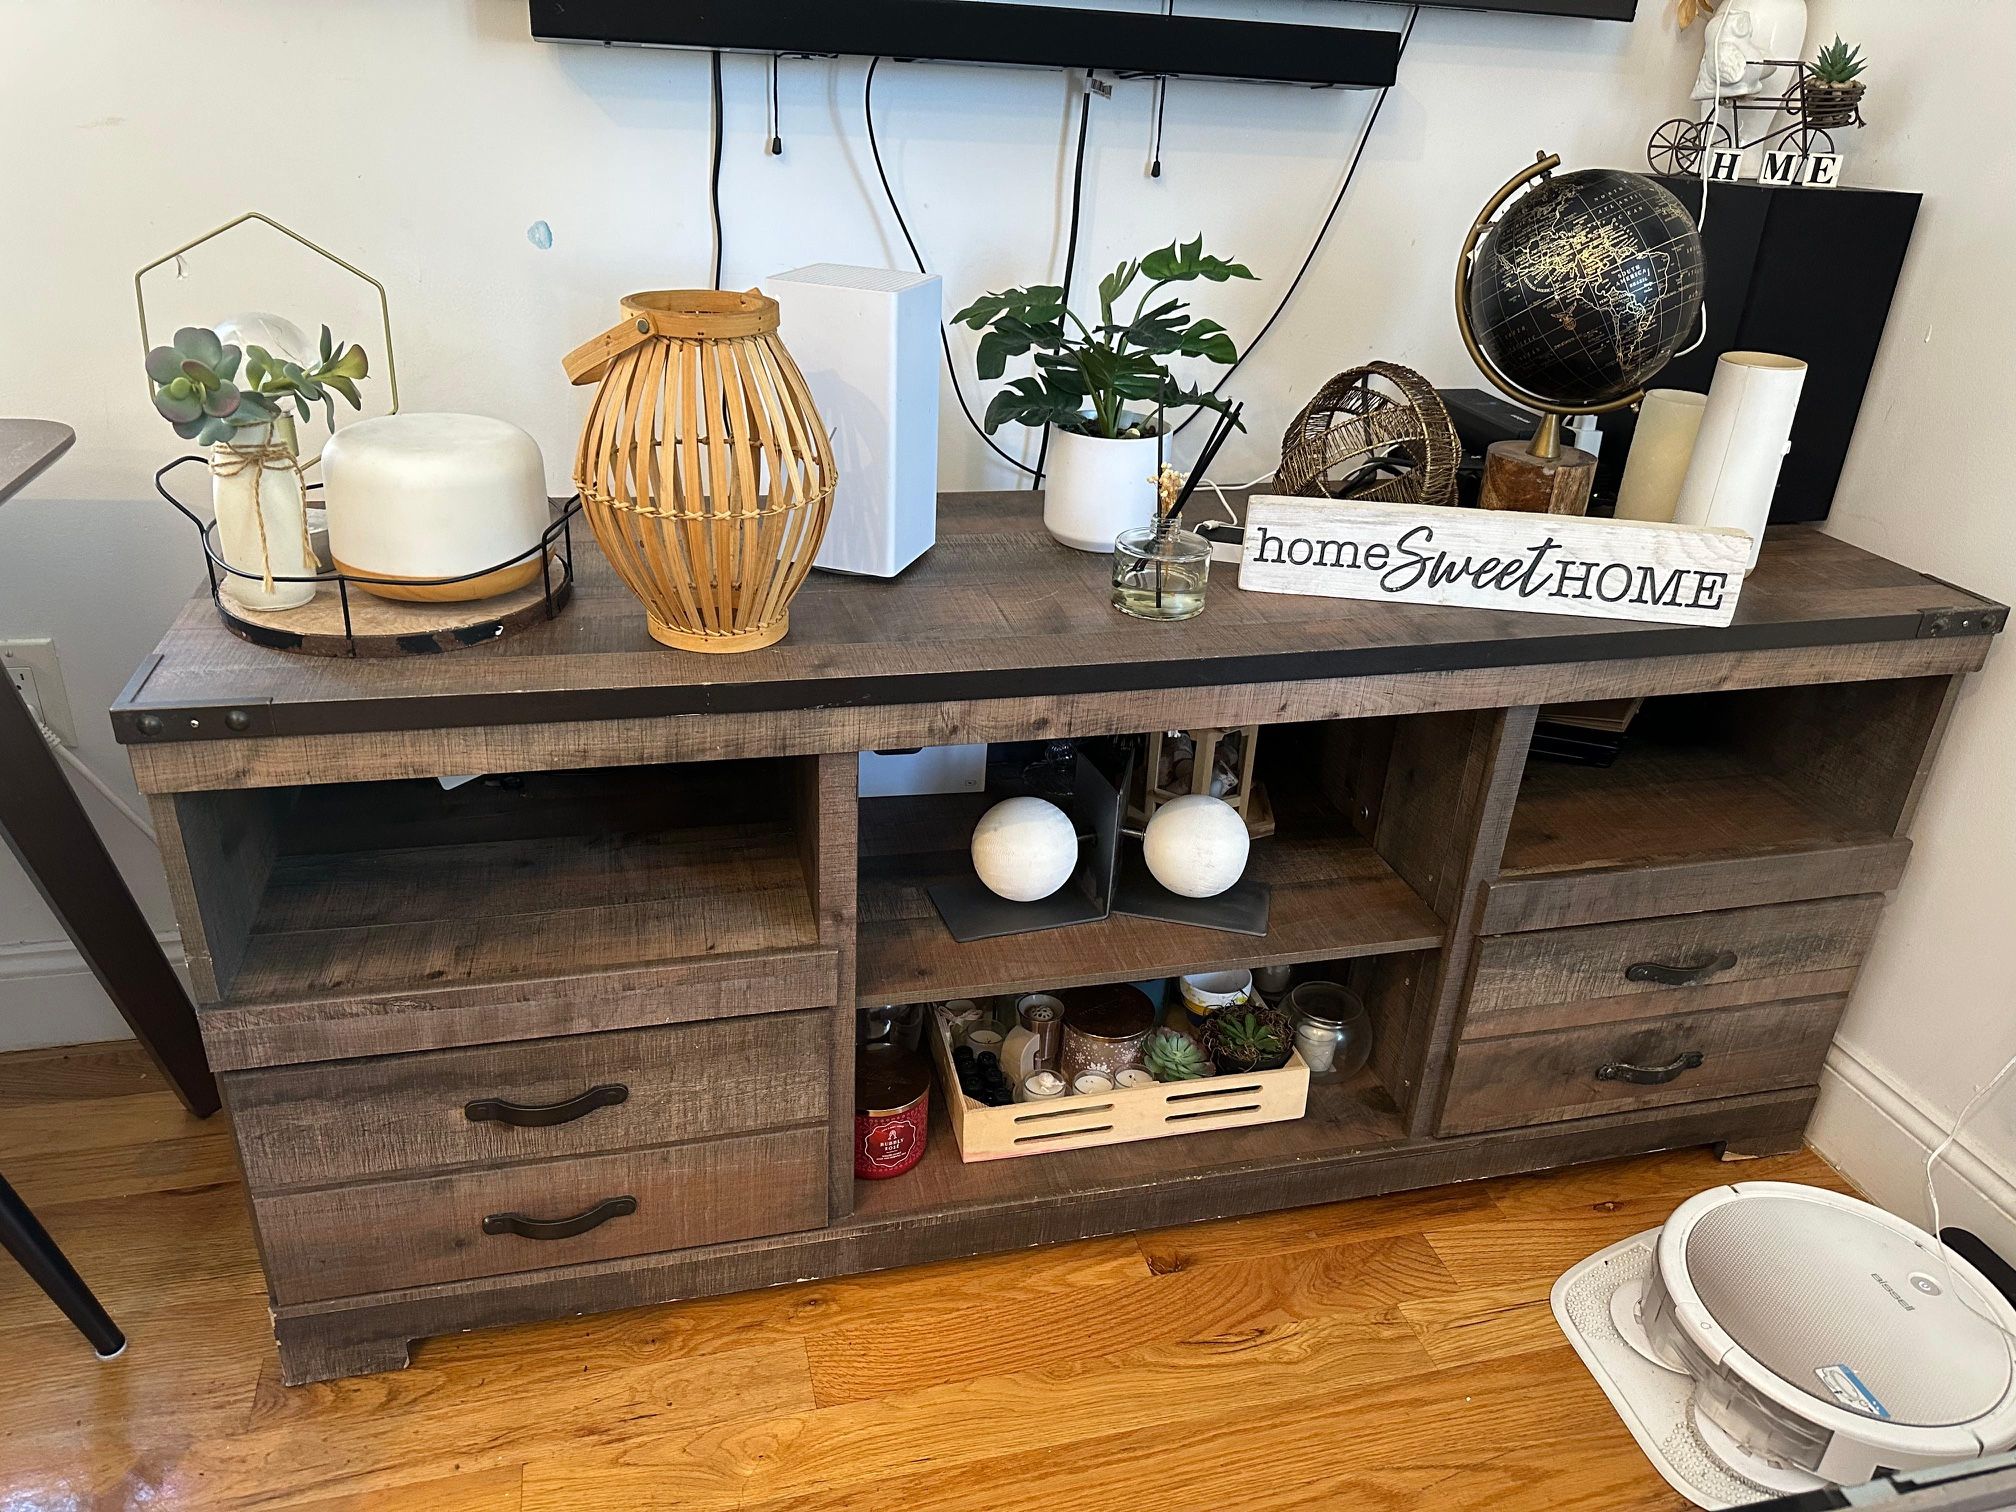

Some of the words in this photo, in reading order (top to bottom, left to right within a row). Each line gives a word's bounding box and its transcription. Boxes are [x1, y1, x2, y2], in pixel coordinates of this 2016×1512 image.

[1711, 152, 1737, 180] H
[1253, 526, 1391, 572] home
[1380, 525, 1562, 597] Sweet
[1547, 558, 1729, 611] HOME
